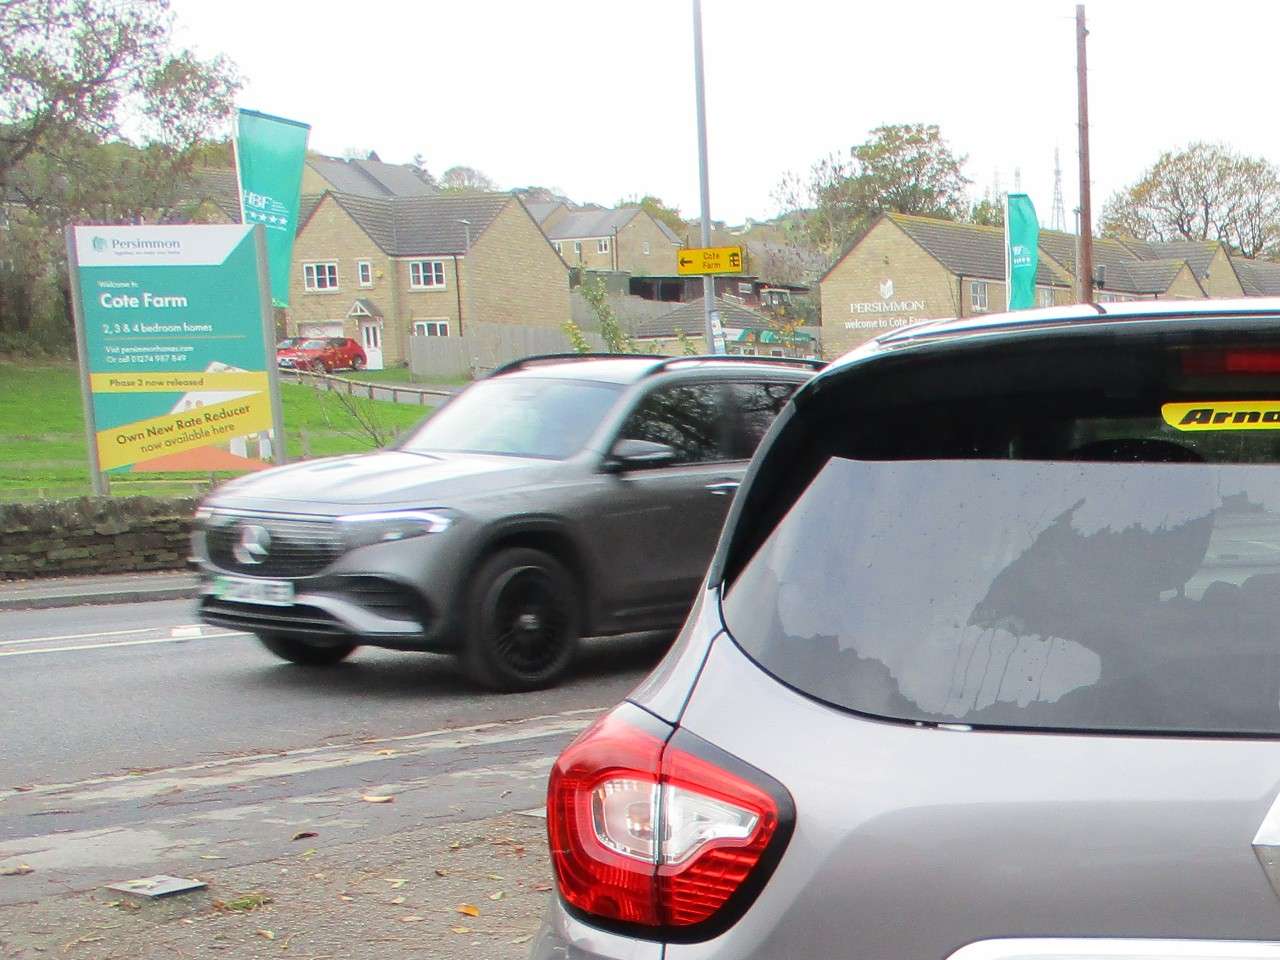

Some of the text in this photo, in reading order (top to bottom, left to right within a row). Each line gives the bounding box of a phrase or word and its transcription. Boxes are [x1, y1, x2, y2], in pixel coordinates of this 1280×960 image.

[112, 238, 180, 249] Persimmon
[704, 252, 720, 260] Cote
[703, 262, 720, 270] Farm
[100, 292, 188, 308] Cote Farm
[850, 301, 926, 313] PERSIMMON
[115, 323, 122, 333] 3
[132, 322, 139, 333] 4
[141, 322, 181, 333] bedroom
[183, 322, 213, 332] homes
[844, 319, 878, 329] welcome
[879, 319, 888, 328] to
[889, 318, 908, 327] Cote
[109, 379, 135, 387] Phase
[166, 378, 204, 387] released
[116, 405, 250, 445] Own New Rate Reducer
[141, 423, 235, 454] now available here
